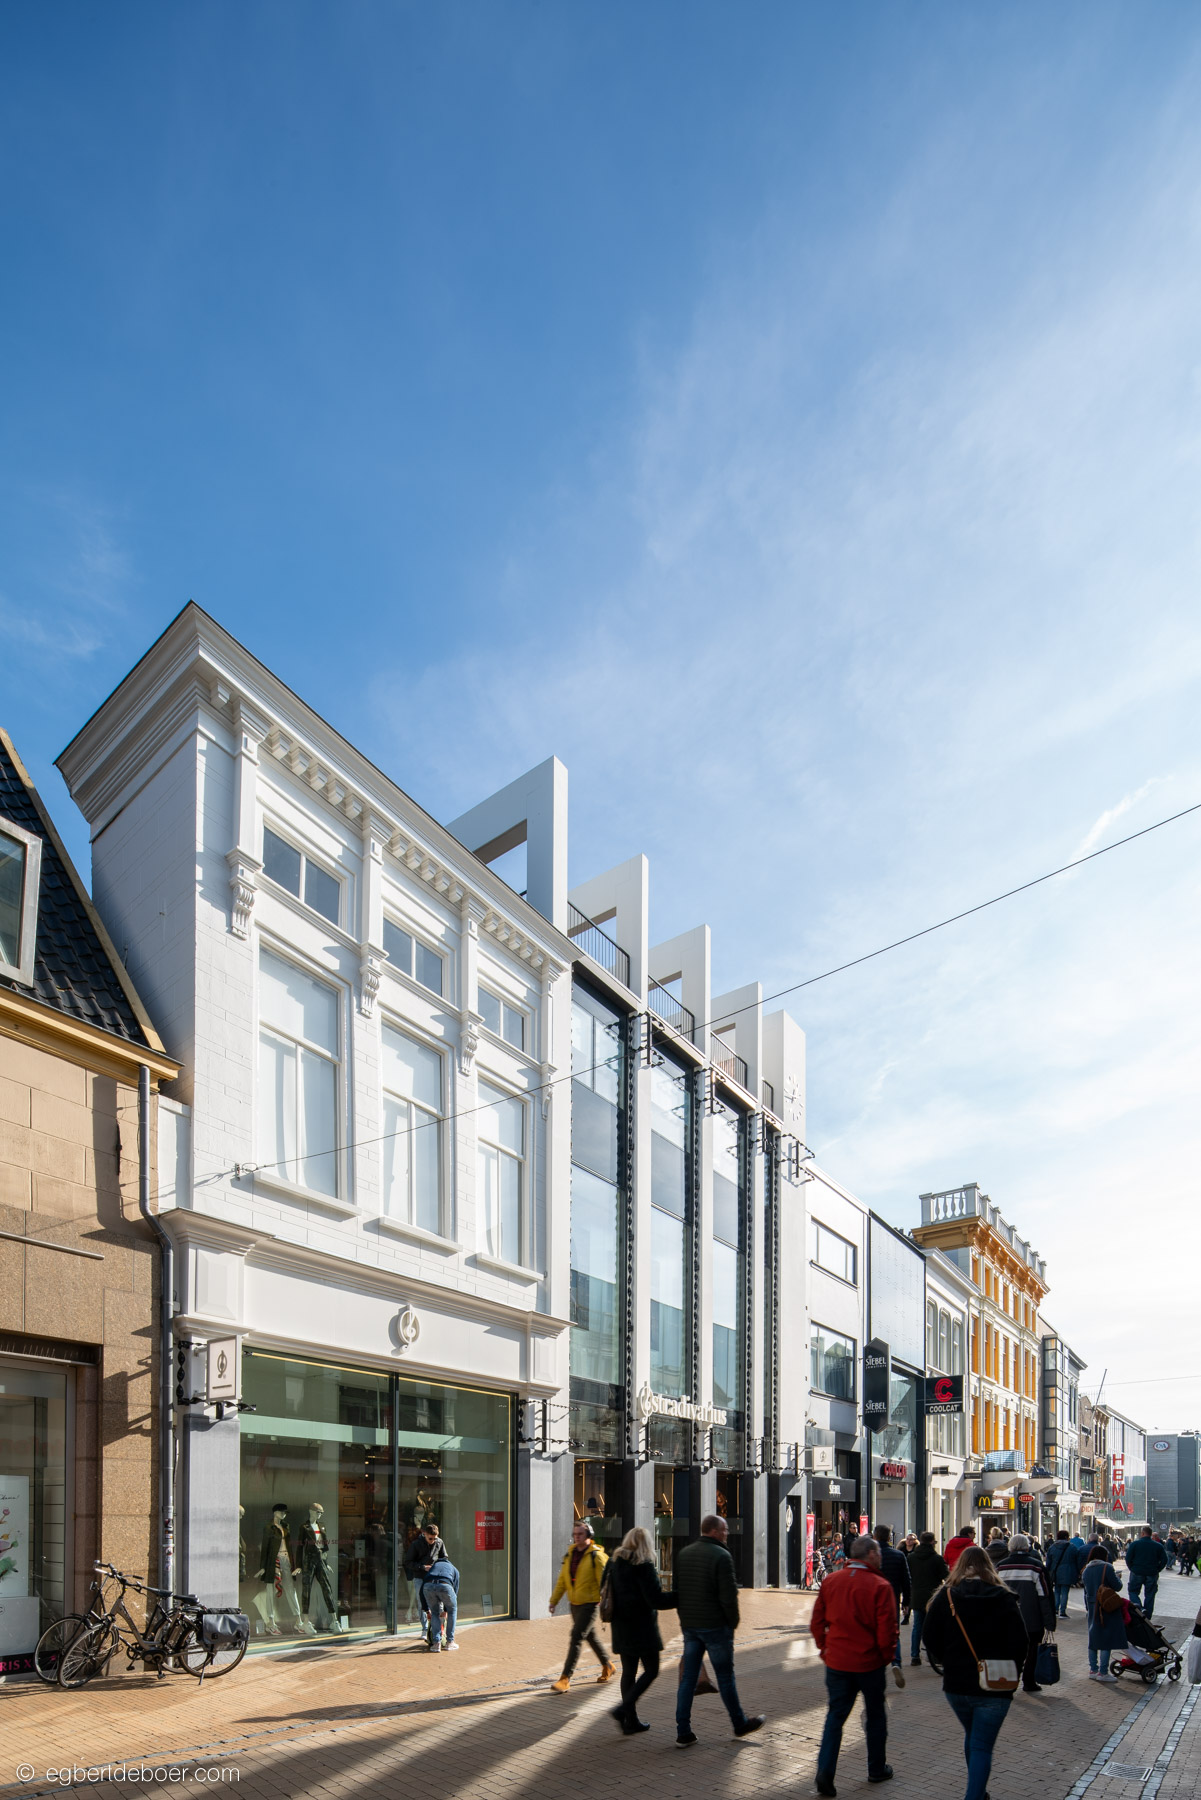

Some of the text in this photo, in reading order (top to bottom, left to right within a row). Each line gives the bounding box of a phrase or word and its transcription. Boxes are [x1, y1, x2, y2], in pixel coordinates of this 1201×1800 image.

[865, 1356, 887, 1366] SIEBEL
[651, 1394, 727, 1426] stradivarius
[865, 1402, 887, 1411] SIEBEL
[929, 1404, 959, 1413] COOLCAT
[1112, 1453, 1125, 1511] HEMA
[1081, 1505, 1094, 1513] DIDI
